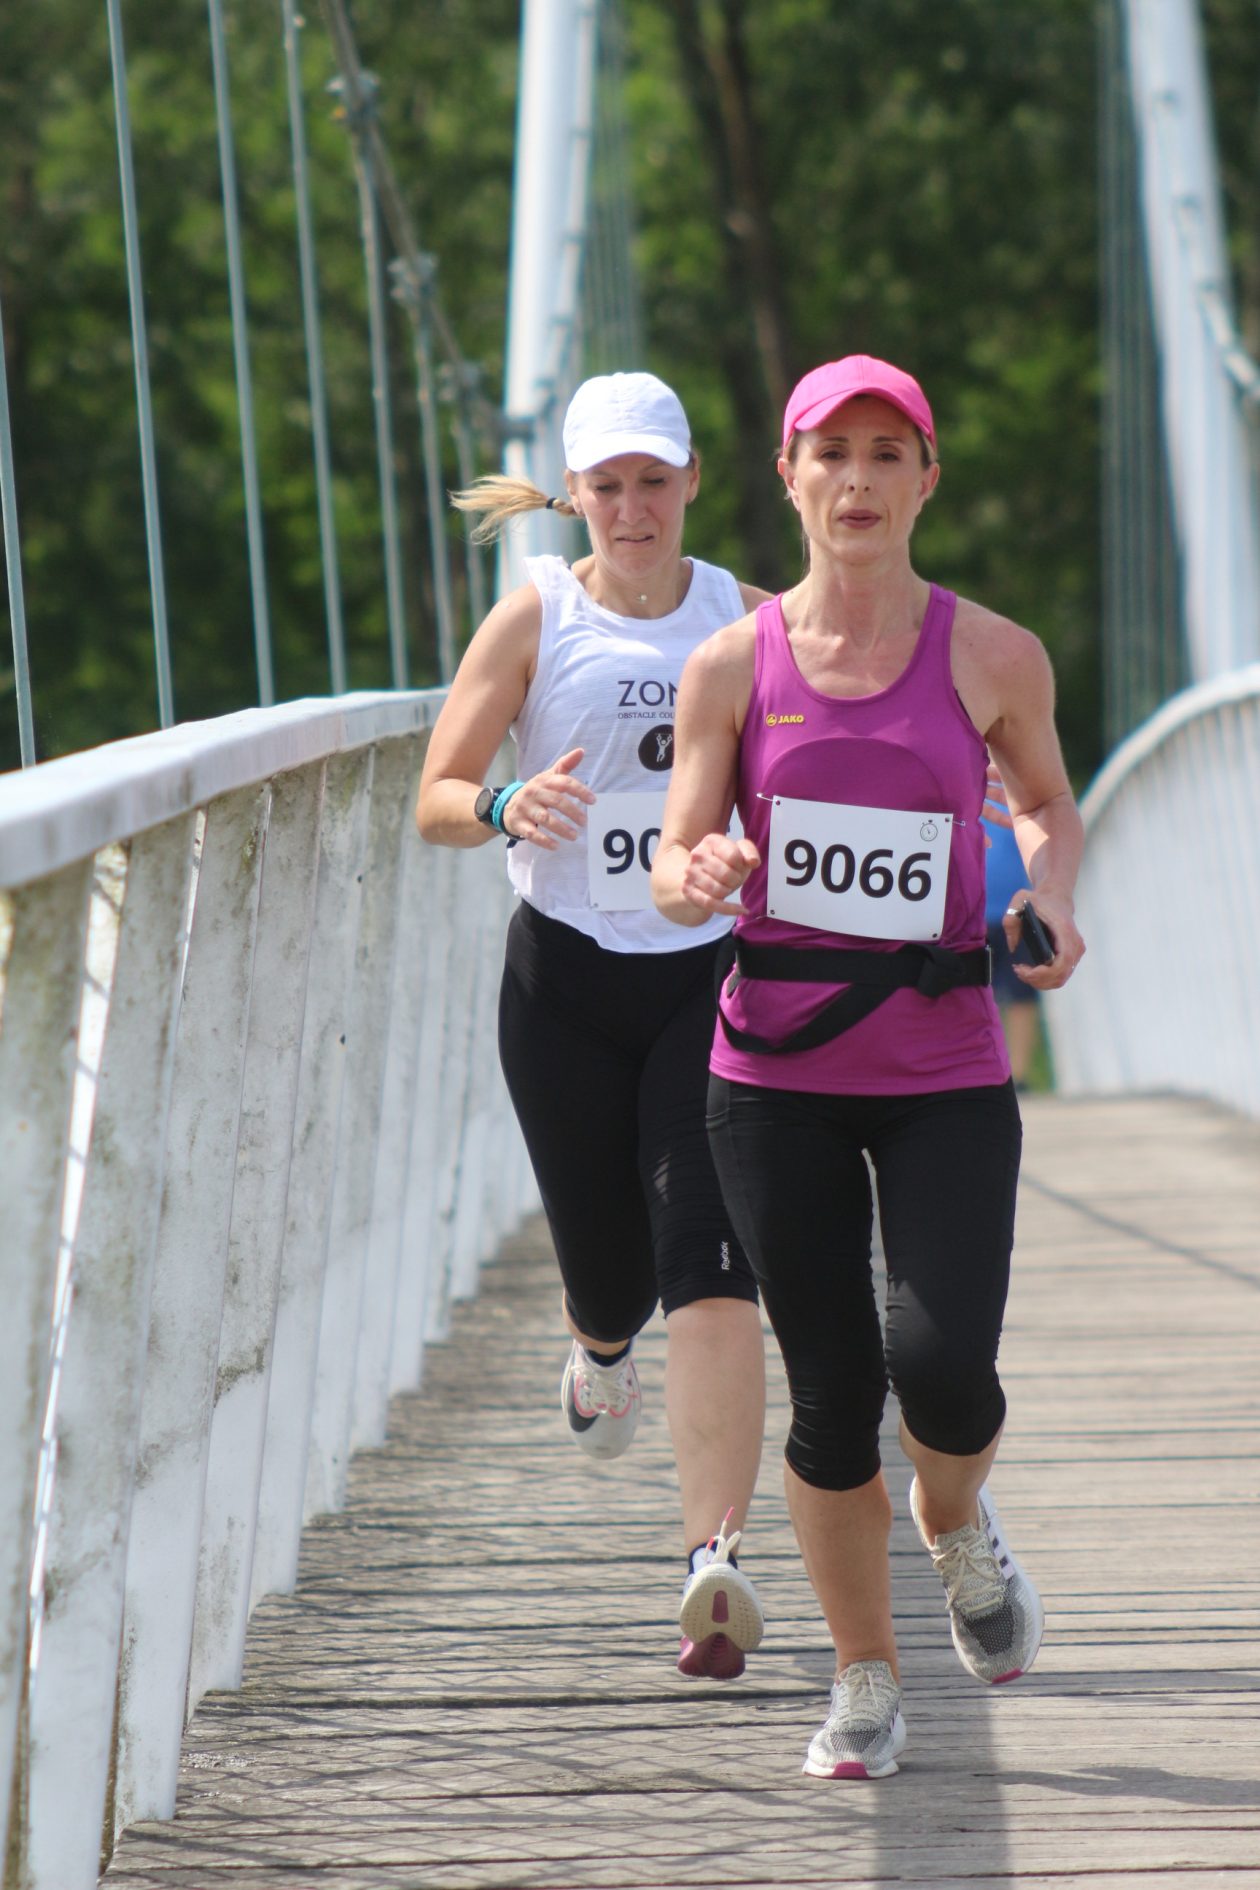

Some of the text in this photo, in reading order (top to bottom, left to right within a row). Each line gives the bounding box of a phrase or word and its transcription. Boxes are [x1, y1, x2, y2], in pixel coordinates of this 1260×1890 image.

[617, 711, 656, 719] OBSTACLE
[778, 715, 804, 724] JAKO
[784, 838, 932, 902] 9066
